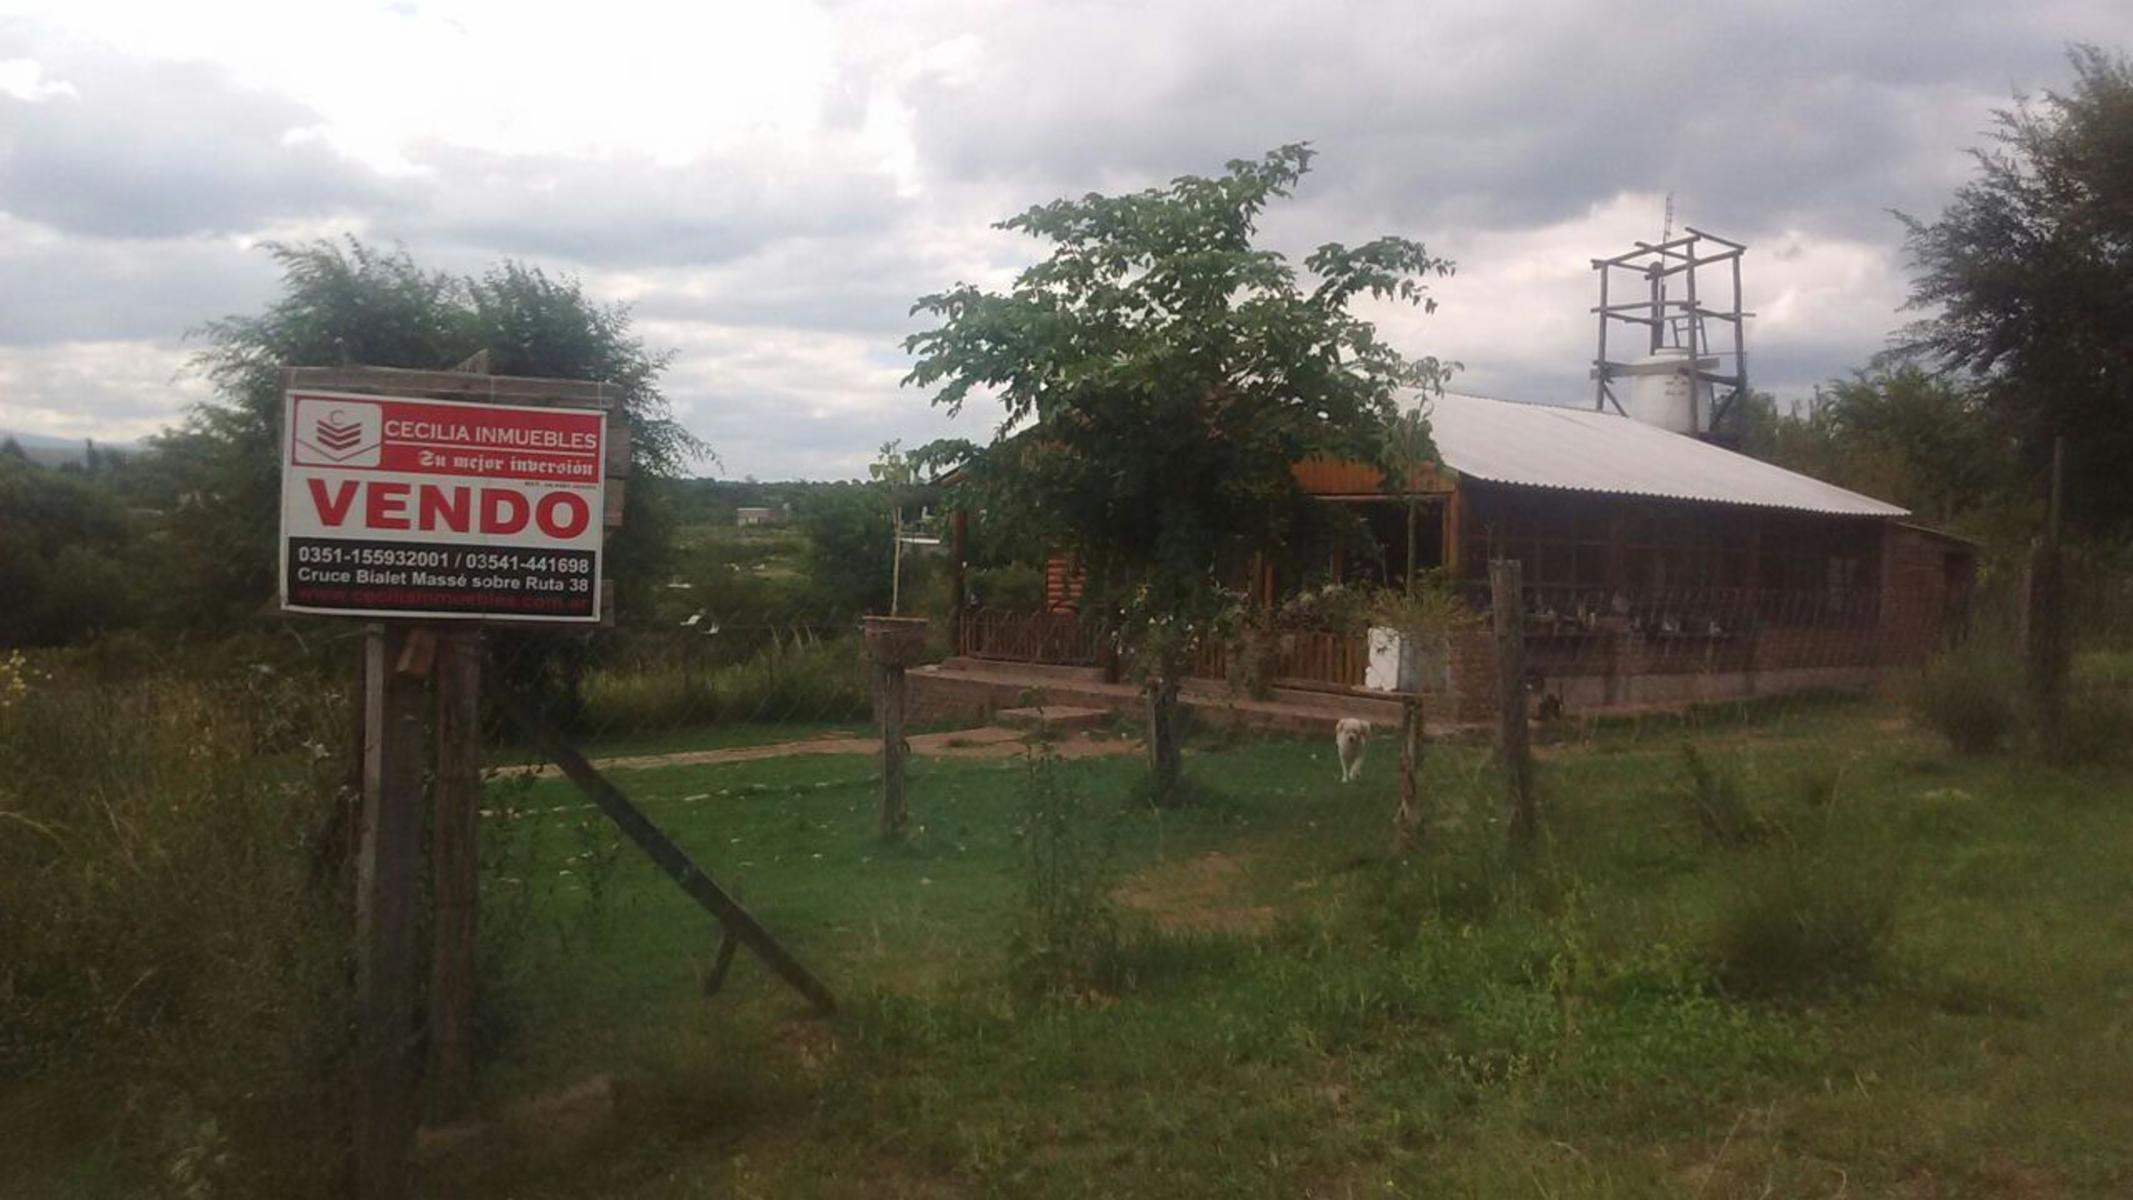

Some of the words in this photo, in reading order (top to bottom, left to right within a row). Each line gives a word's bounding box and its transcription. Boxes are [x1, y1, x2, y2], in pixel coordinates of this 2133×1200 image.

[384, 420, 470, 441] CECILIA
[475, 426, 598, 449] INMUEBLES
[453, 455, 504, 472] mejor
[510, 456, 593, 476] inversión
[306, 478, 590, 539] VENDO
[298, 546, 449, 568] 0351-155932001
[465, 553, 589, 574] 03541-441698
[298, 567, 351, 583] Cruce
[356, 569, 407, 586] Bialet
[412, 572, 467, 588] Massé
[471, 575, 521, 590] sobre
[525, 576, 565, 592] Ruta
[569, 578, 589, 592] 38
